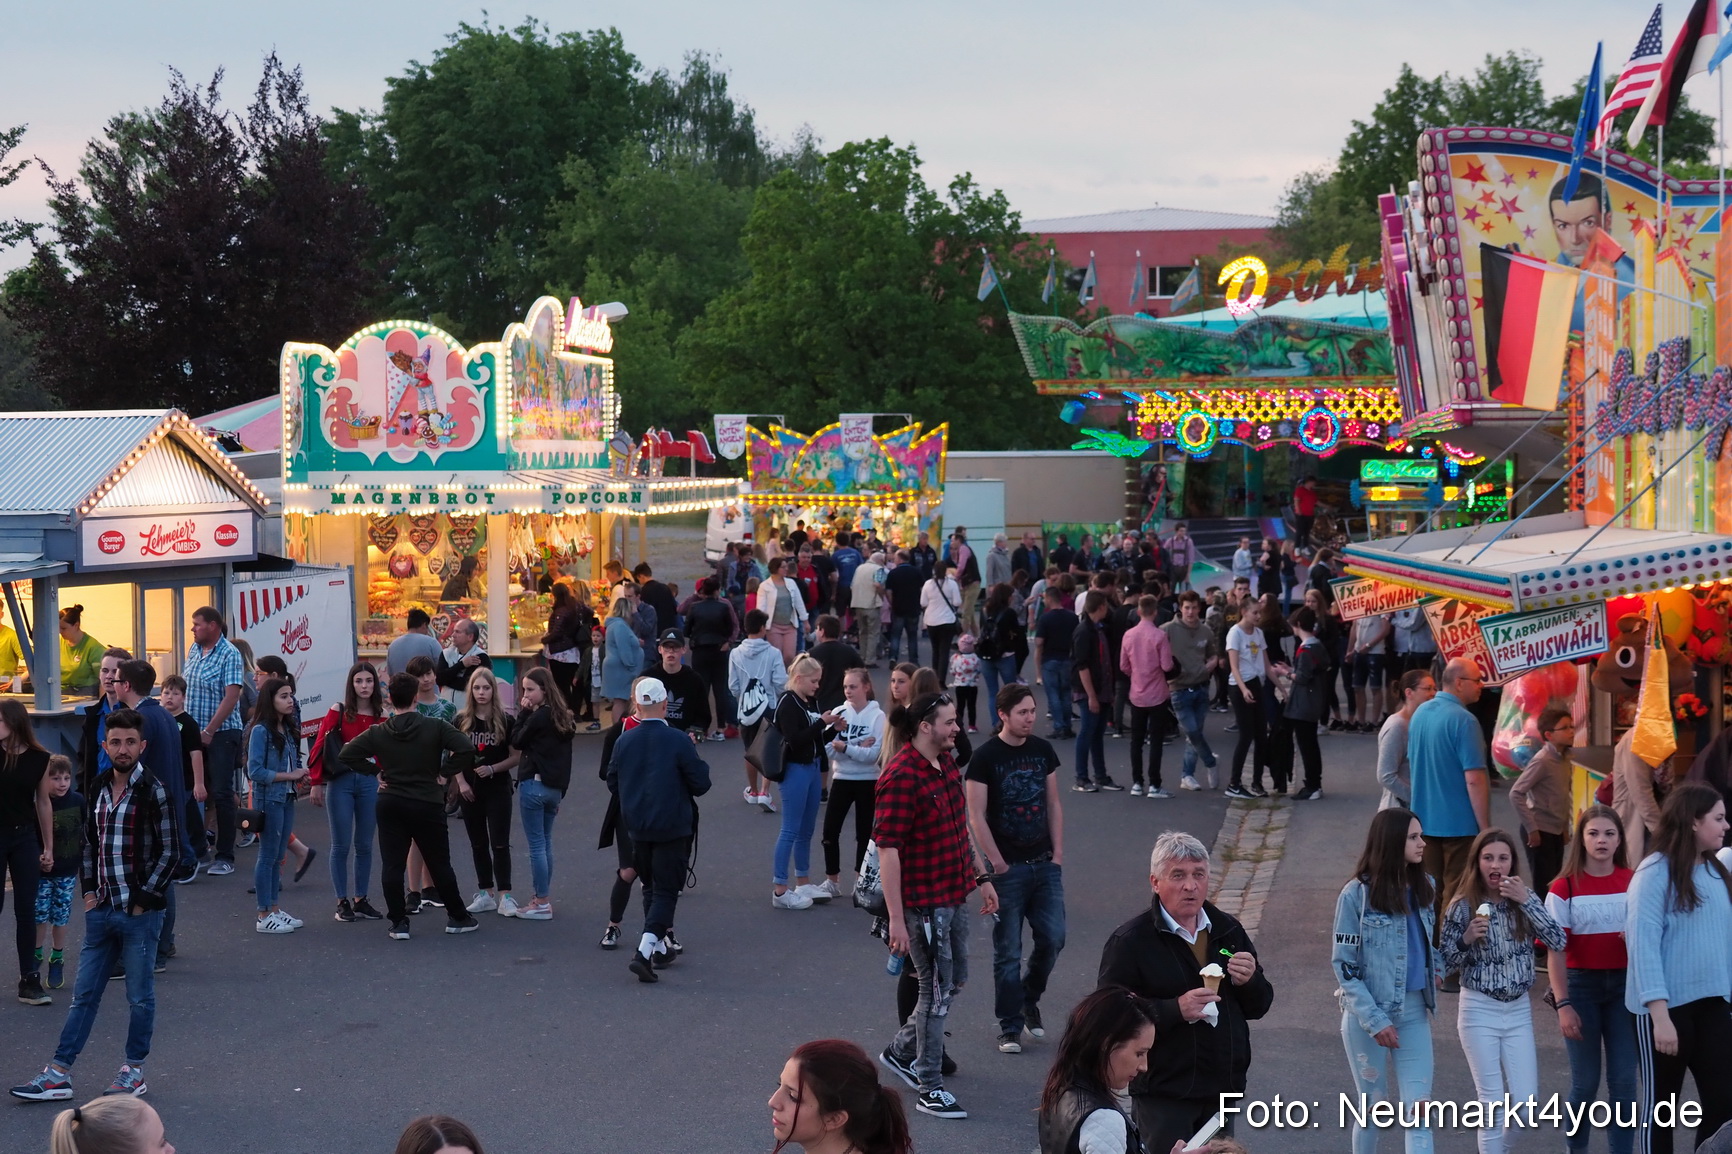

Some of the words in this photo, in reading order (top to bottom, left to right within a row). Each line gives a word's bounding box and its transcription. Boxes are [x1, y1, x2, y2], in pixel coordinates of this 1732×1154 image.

[330, 492, 496, 505] MAGENBROT
[551, 491, 642, 505] POPCORN
[101, 534, 123, 543] Gourmet
[139, 518, 196, 556] Lehmeier's
[215, 530, 238, 540] Klassiker
[103, 543, 121, 552] Burger
[175, 541, 198, 552] IMBISS
[1343, 596, 1365, 612] FREIE
[1365, 588, 1424, 616] AUSWAHL
[1515, 609, 1580, 640] ABRÄUMEN:
[1496, 641, 1527, 663] FREIE
[1526, 621, 1603, 666] AUSWAHL
[1335, 933, 1360, 945] WHAT
